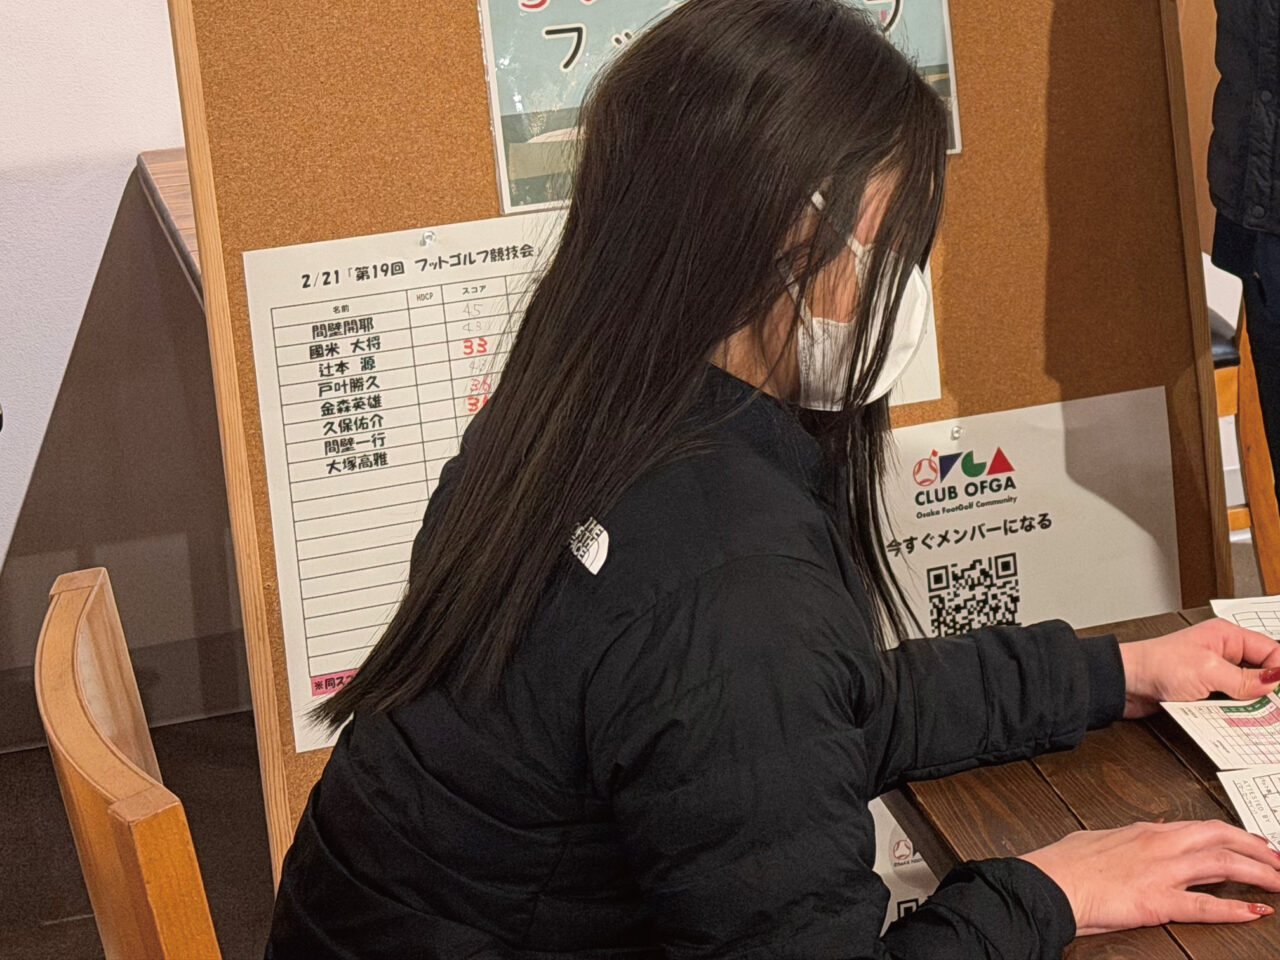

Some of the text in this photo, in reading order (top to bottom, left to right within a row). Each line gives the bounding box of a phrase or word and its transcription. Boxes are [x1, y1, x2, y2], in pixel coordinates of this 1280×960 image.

[416, 292, 434, 302] HDCP
[462, 285, 487, 295] スコア
[333, 304, 350, 314] 名前
[350, 336, 381, 353] 大将
[463, 337, 487, 355] 33
[319, 356, 376, 377] 辻本 源
[321, 394, 382, 417] 金森英雄
[323, 414, 384, 436] 久保佑介
[324, 432, 386, 456] 間壁一行
[326, 452, 389, 474] 大塚高雅
[915, 476, 1017, 506] CLUB OFGA
[916, 495, 1018, 519] Osaka FootGolf Community
[886, 513, 1052, 557] 今すぐメンバーになる
